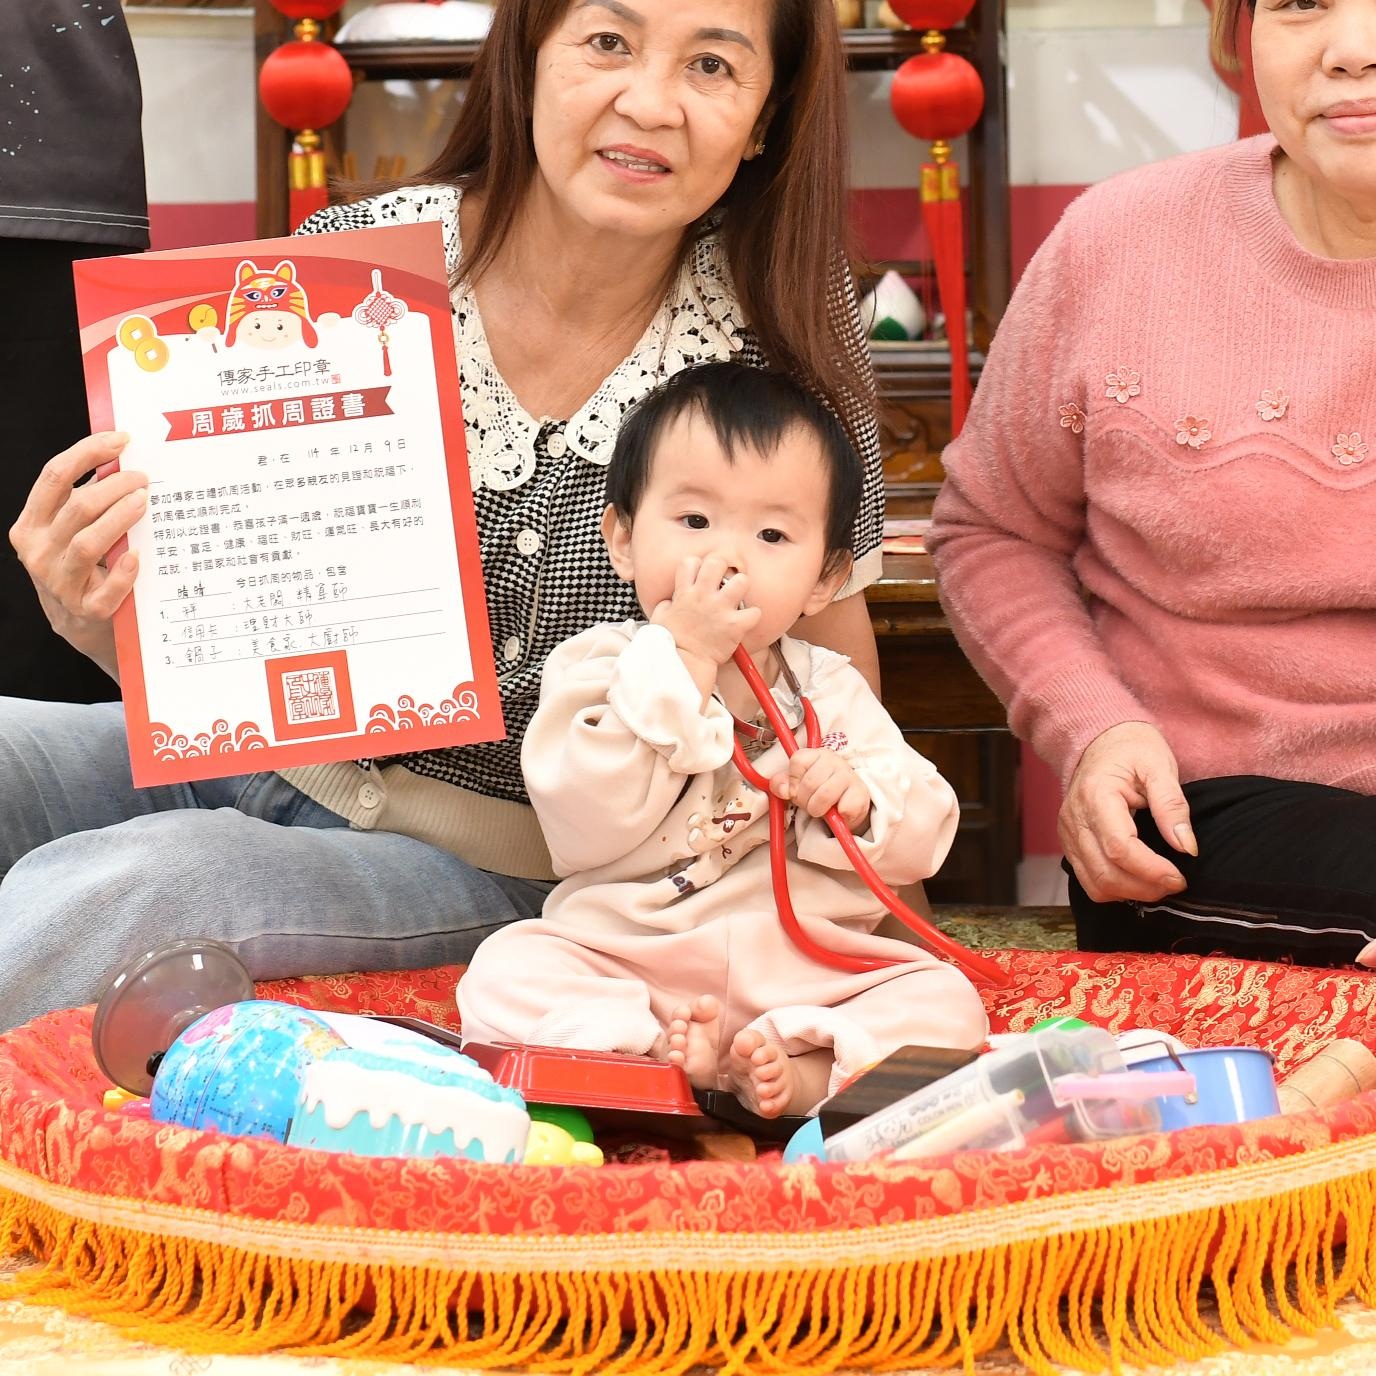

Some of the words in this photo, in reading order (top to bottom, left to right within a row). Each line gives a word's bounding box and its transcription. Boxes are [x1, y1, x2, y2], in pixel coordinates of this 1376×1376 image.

[217, 359, 331, 387] 傳家手工印章
[191, 392, 366, 436] 周歲抓周證書
